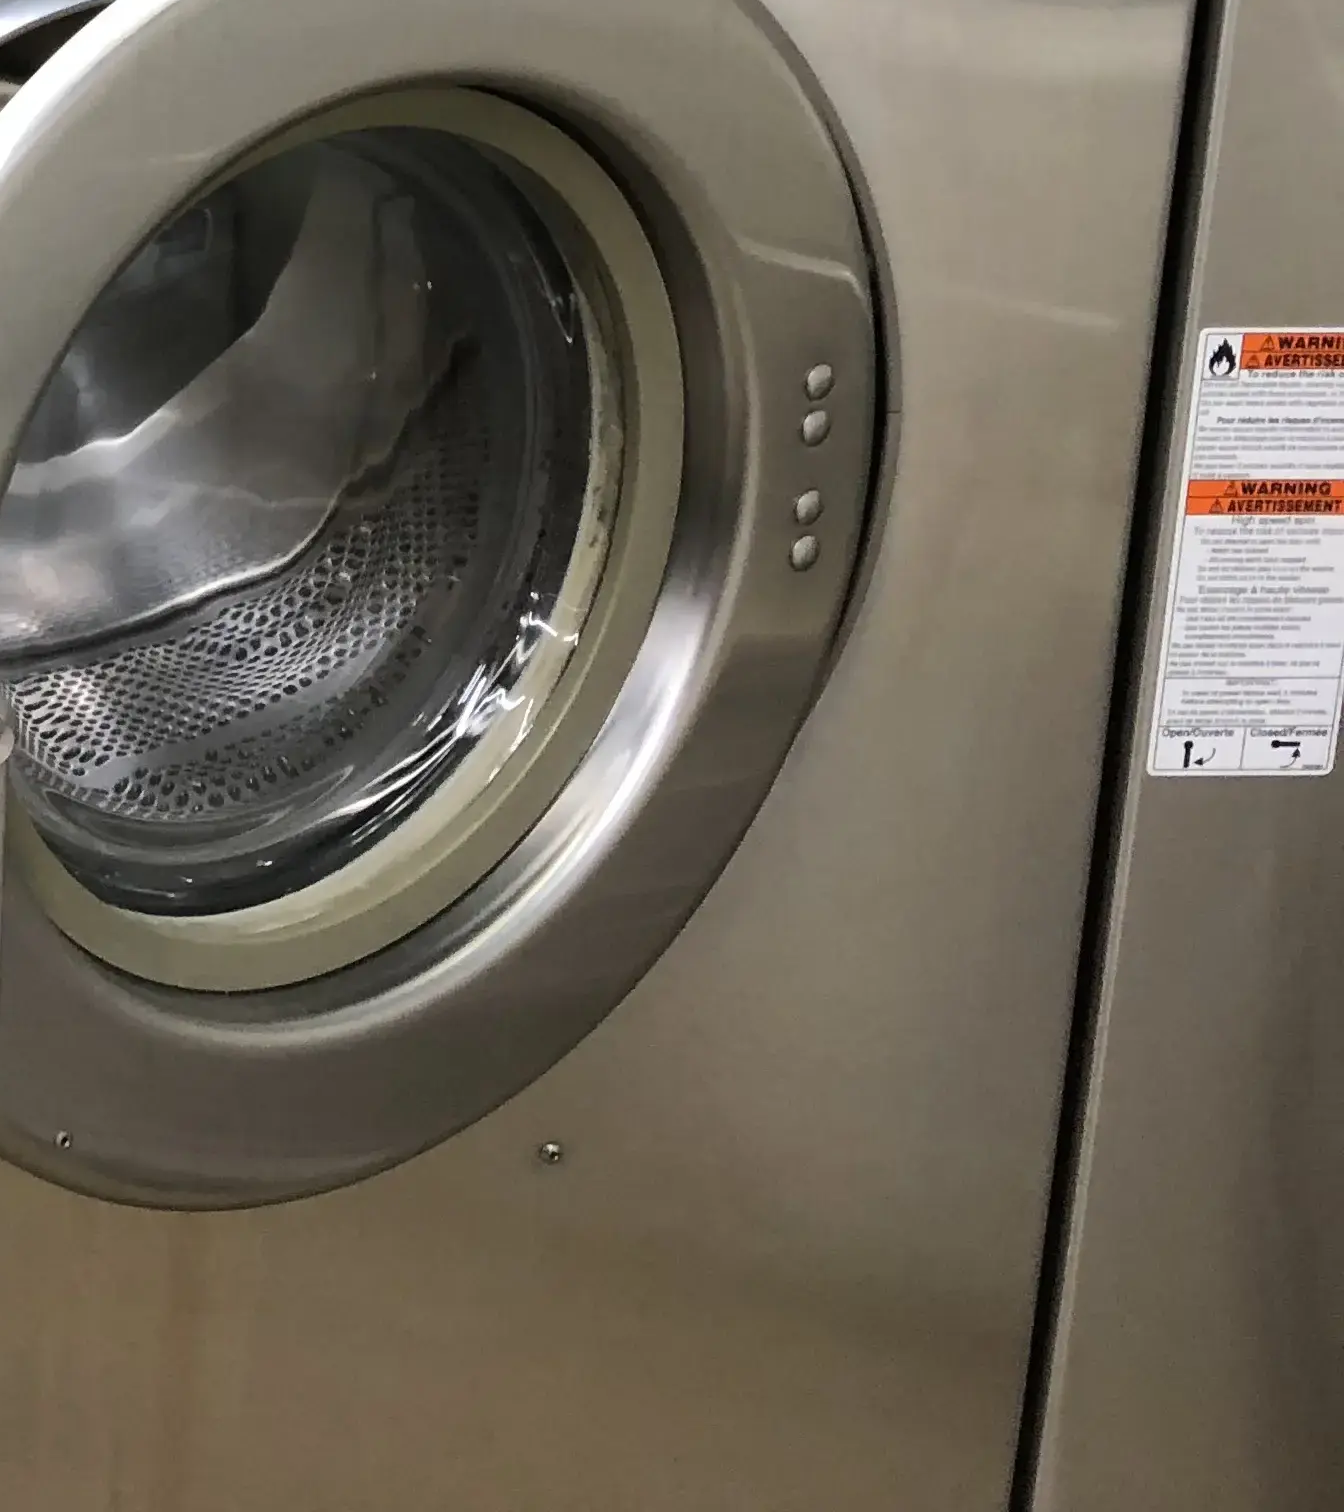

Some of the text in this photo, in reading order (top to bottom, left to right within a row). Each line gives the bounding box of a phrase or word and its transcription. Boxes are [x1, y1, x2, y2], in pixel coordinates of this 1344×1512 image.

[1278, 336, 1344, 350] WARNI
[1264, 354, 1344, 367] AVERTISSE
[1241, 483, 1332, 495] WARNING
[1227, 500, 1342, 513] AVERTISSEMENT
